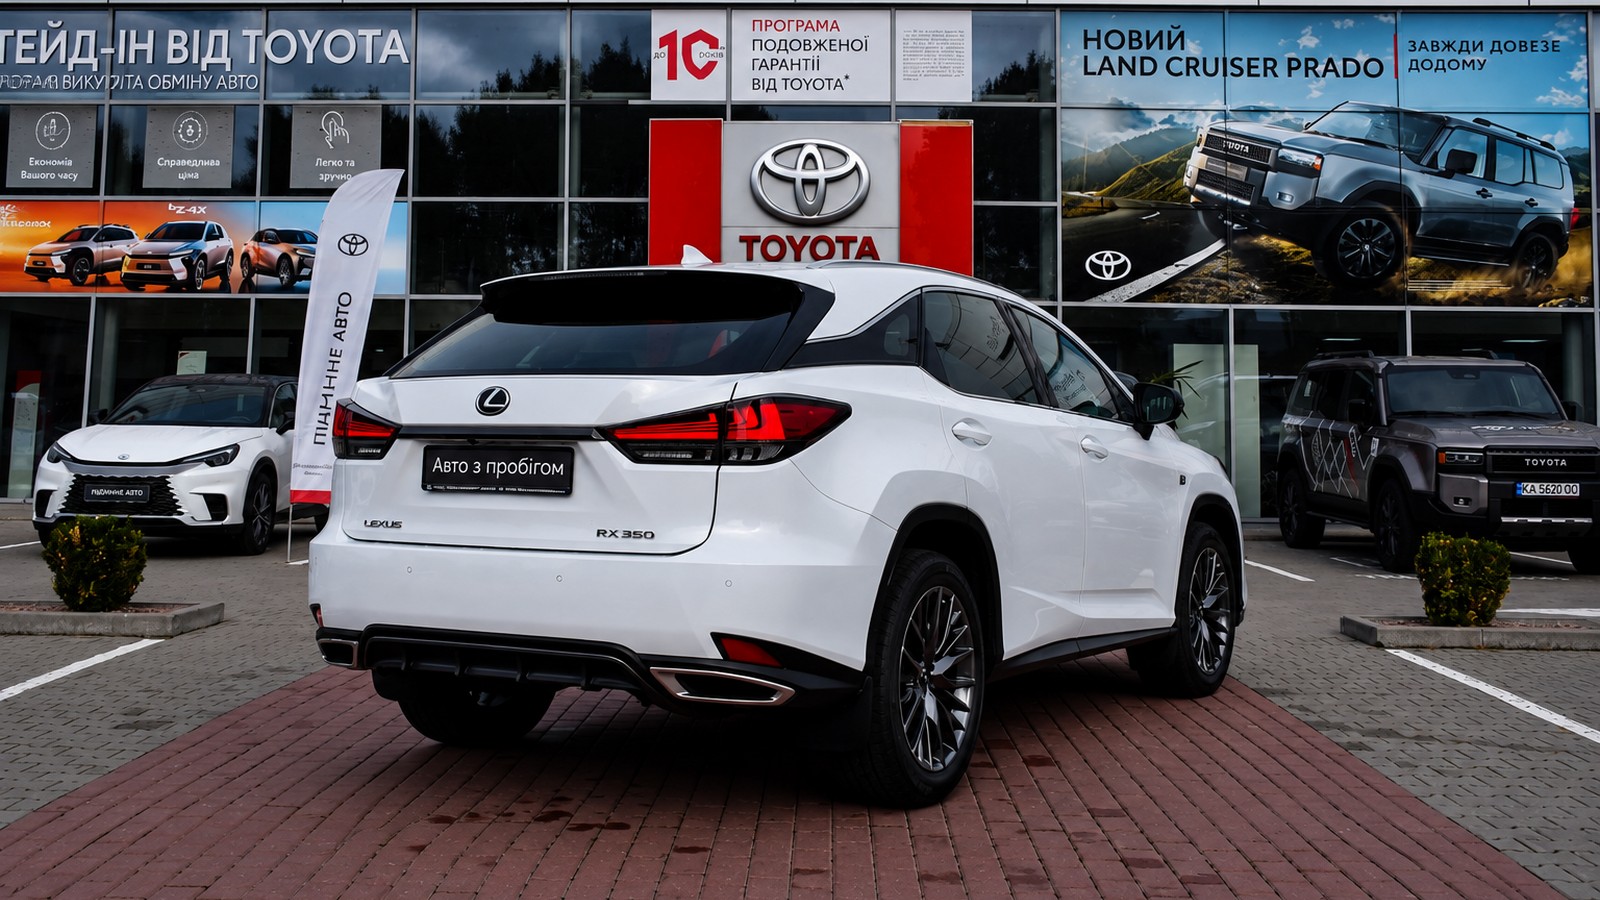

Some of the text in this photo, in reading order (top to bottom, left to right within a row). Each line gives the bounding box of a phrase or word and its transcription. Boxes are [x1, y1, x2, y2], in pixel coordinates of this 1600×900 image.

[752, 19, 841, 32] ПРОГРАМА
[752, 35, 869, 53] ПОДОВЖЕНОЇ
[1083, 24, 1185, 51] НОВИЙ
[166, 29, 233, 71] ВІД
[242, 29, 409, 65] TOYOTA
[1408, 39, 1561, 55] ЗАВЖДИ ДОВЕЗЕ
[1083, 55, 1385, 78] LAND CRUISER PRADO
[1408, 58, 1487, 73] ДОДОМУ
[148, 74, 212, 90] ОБМІНУ
[216, 74, 258, 90] АВТО
[752, 78, 777, 92] ВІД
[315, 158, 355, 167] Легко та
[739, 235, 880, 261] TOYOTA
[333, 291, 353, 342] АВТО
[432, 456, 565, 479] Авто з пробігом
[1524, 458, 1567, 467] TOYOTA
[1522, 483, 1537, 495] KA
[1539, 483, 1562, 495] 5620
[364, 519, 403, 529] LEXUS
[596, 529, 655, 540] RX 350
